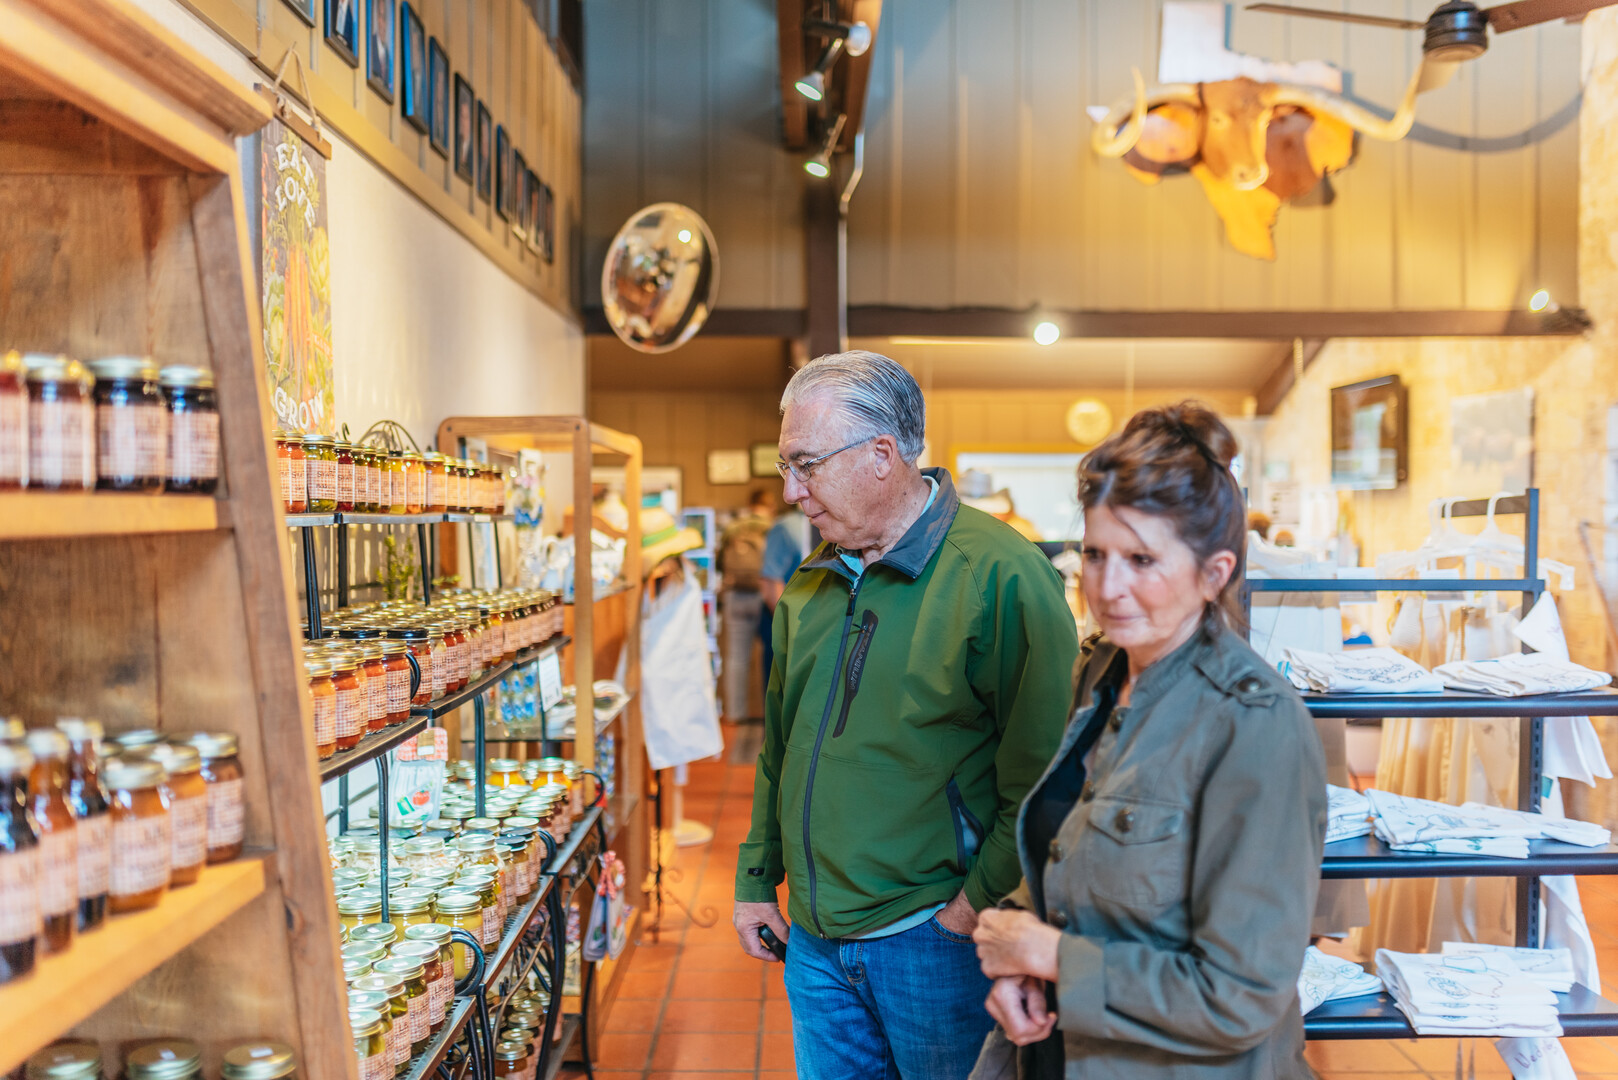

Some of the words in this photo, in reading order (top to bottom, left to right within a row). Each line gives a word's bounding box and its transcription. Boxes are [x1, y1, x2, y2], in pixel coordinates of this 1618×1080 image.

[276, 143, 315, 188] EAT
[275, 176, 315, 231] LOVE
[275, 387, 324, 430] GROW
